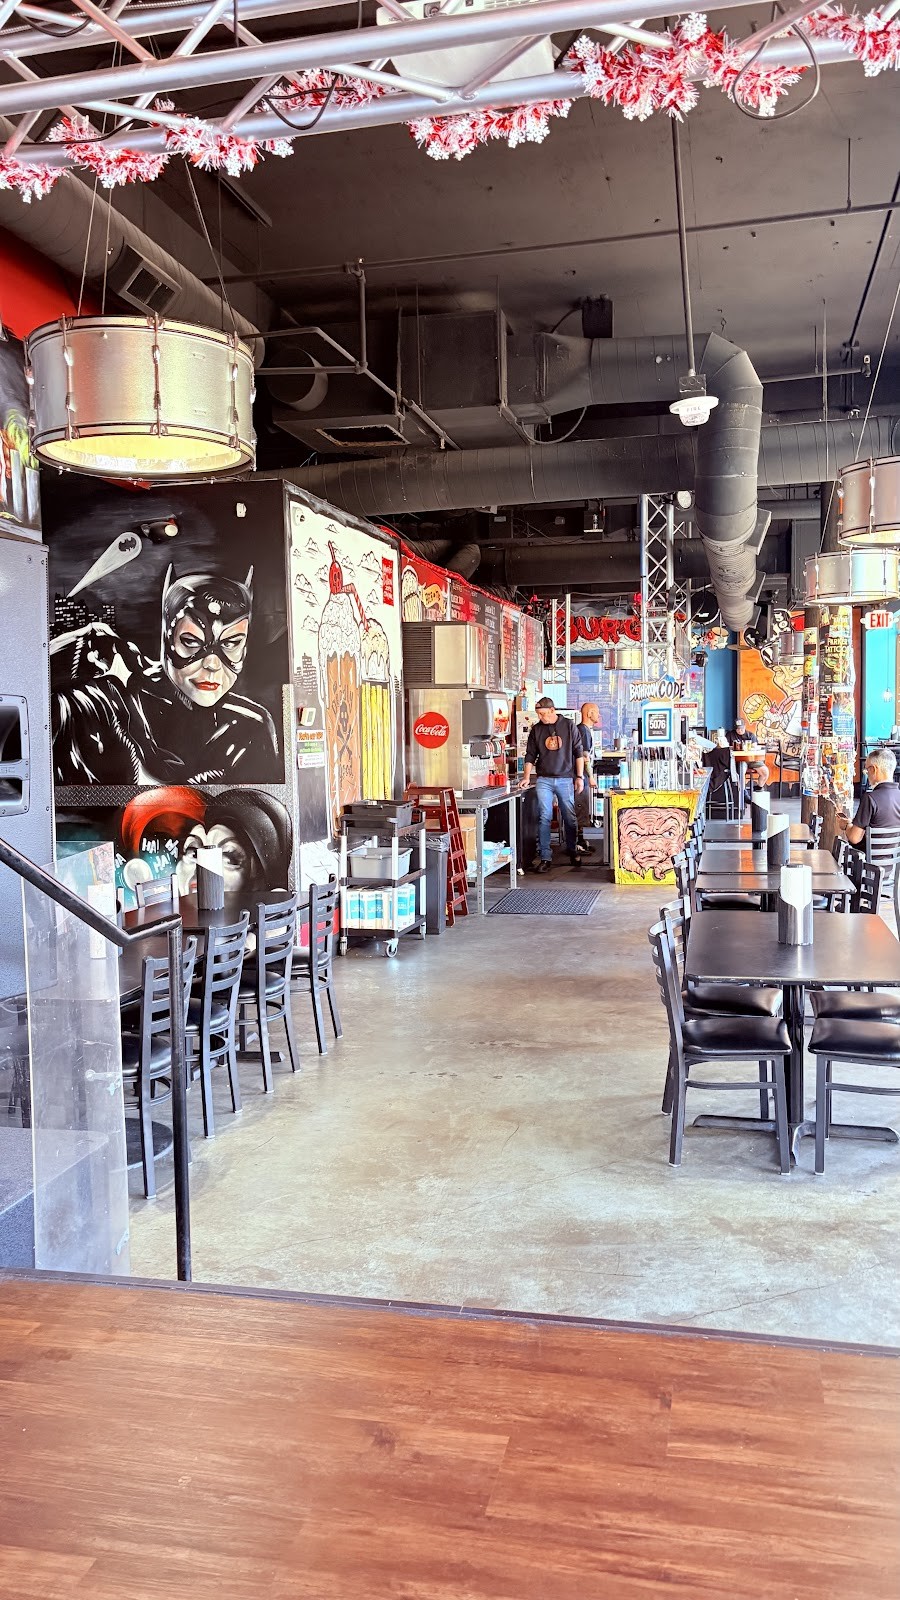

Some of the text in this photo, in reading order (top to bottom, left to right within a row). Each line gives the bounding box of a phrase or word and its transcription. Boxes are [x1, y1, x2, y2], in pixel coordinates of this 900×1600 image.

[870, 613, 889, 628] EXIT
[658, 680, 685, 699] CODE
[415, 723, 449, 737] Coca-Cola
[650, 720, 666, 729] 5076
[142, 838, 159, 854] HA!
